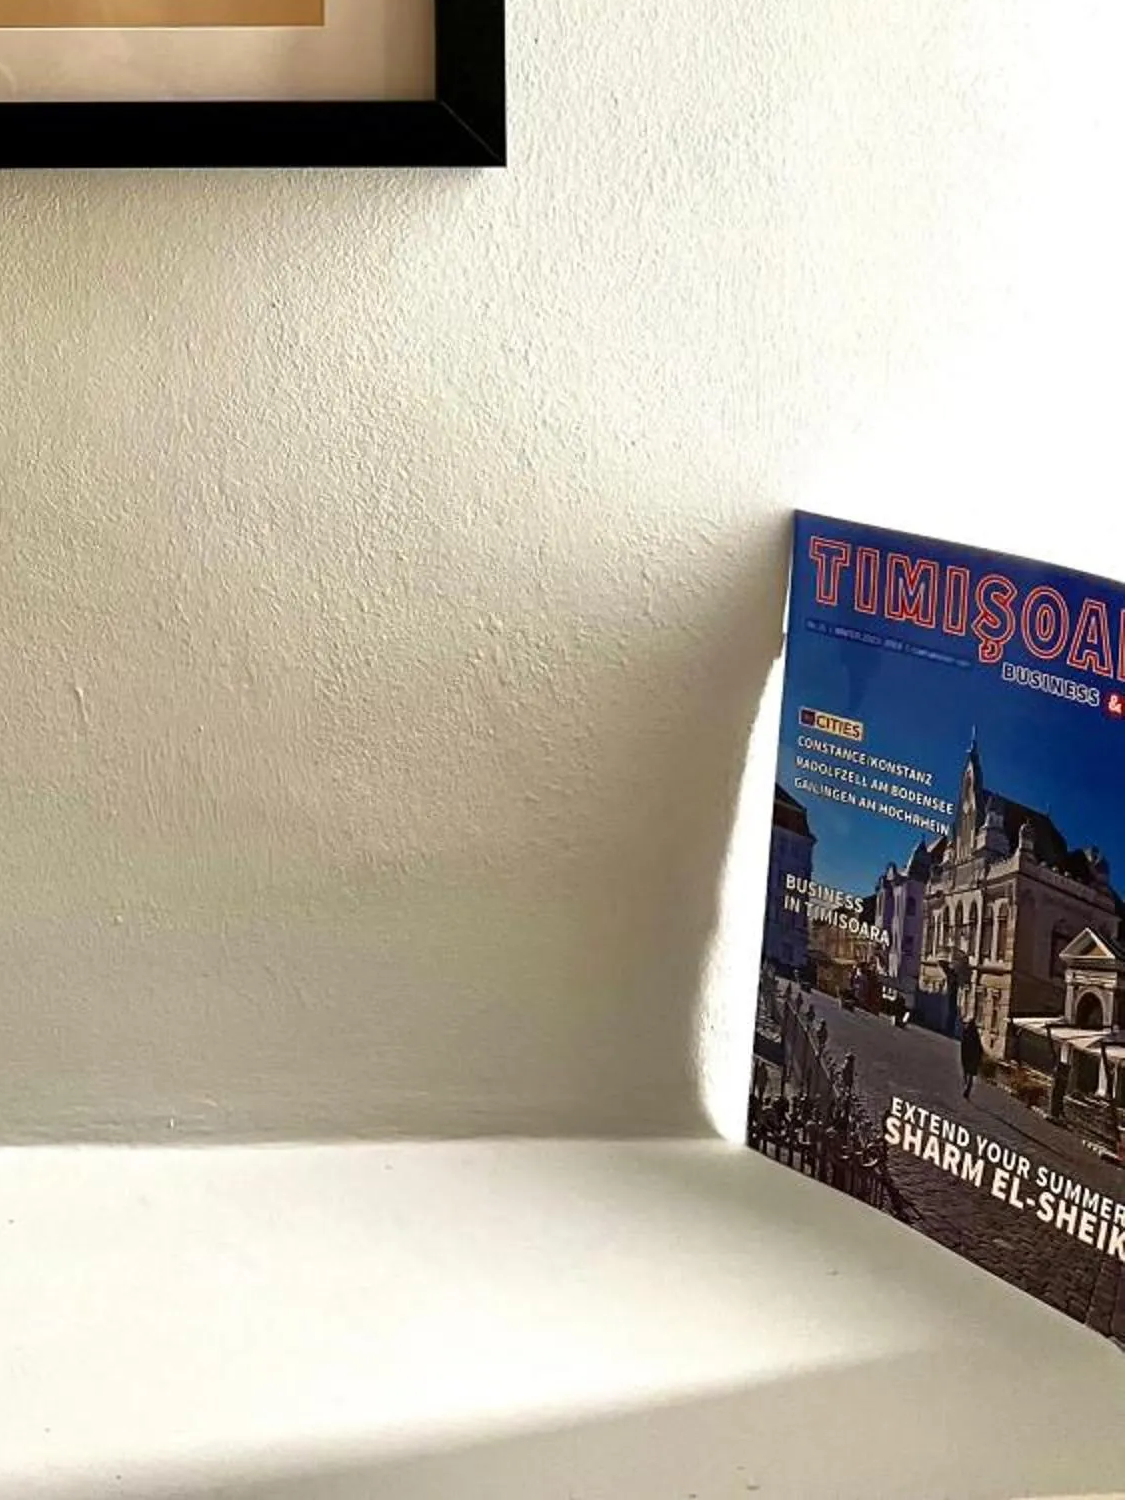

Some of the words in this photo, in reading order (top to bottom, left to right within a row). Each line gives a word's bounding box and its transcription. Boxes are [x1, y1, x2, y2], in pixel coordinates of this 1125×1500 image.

[1002, 662, 1100, 707] BUSINESS
[1108, 694, 1123, 714] &
[816, 714, 861, 738] CITIES
[794, 777, 856, 805] GAILINGEN
[858, 797, 876, 811] AM
[878, 804, 951, 836] HOCHRHEIN
[795, 755, 868, 788] RADOLFZELL
[870, 779, 889, 794] AM
[890, 783, 955, 815] BODENSEE
[784, 895, 800, 913] IN
[804, 901, 890, 947] TIMISOARA
[786, 873, 864, 914] BUSINESS
[884, 1115, 985, 1188] SHARM
[890, 1096, 970, 1148] EXTEND
[976, 1134, 1031, 1180] YOUR
[1035, 1165, 1125, 1228] SUMMER
